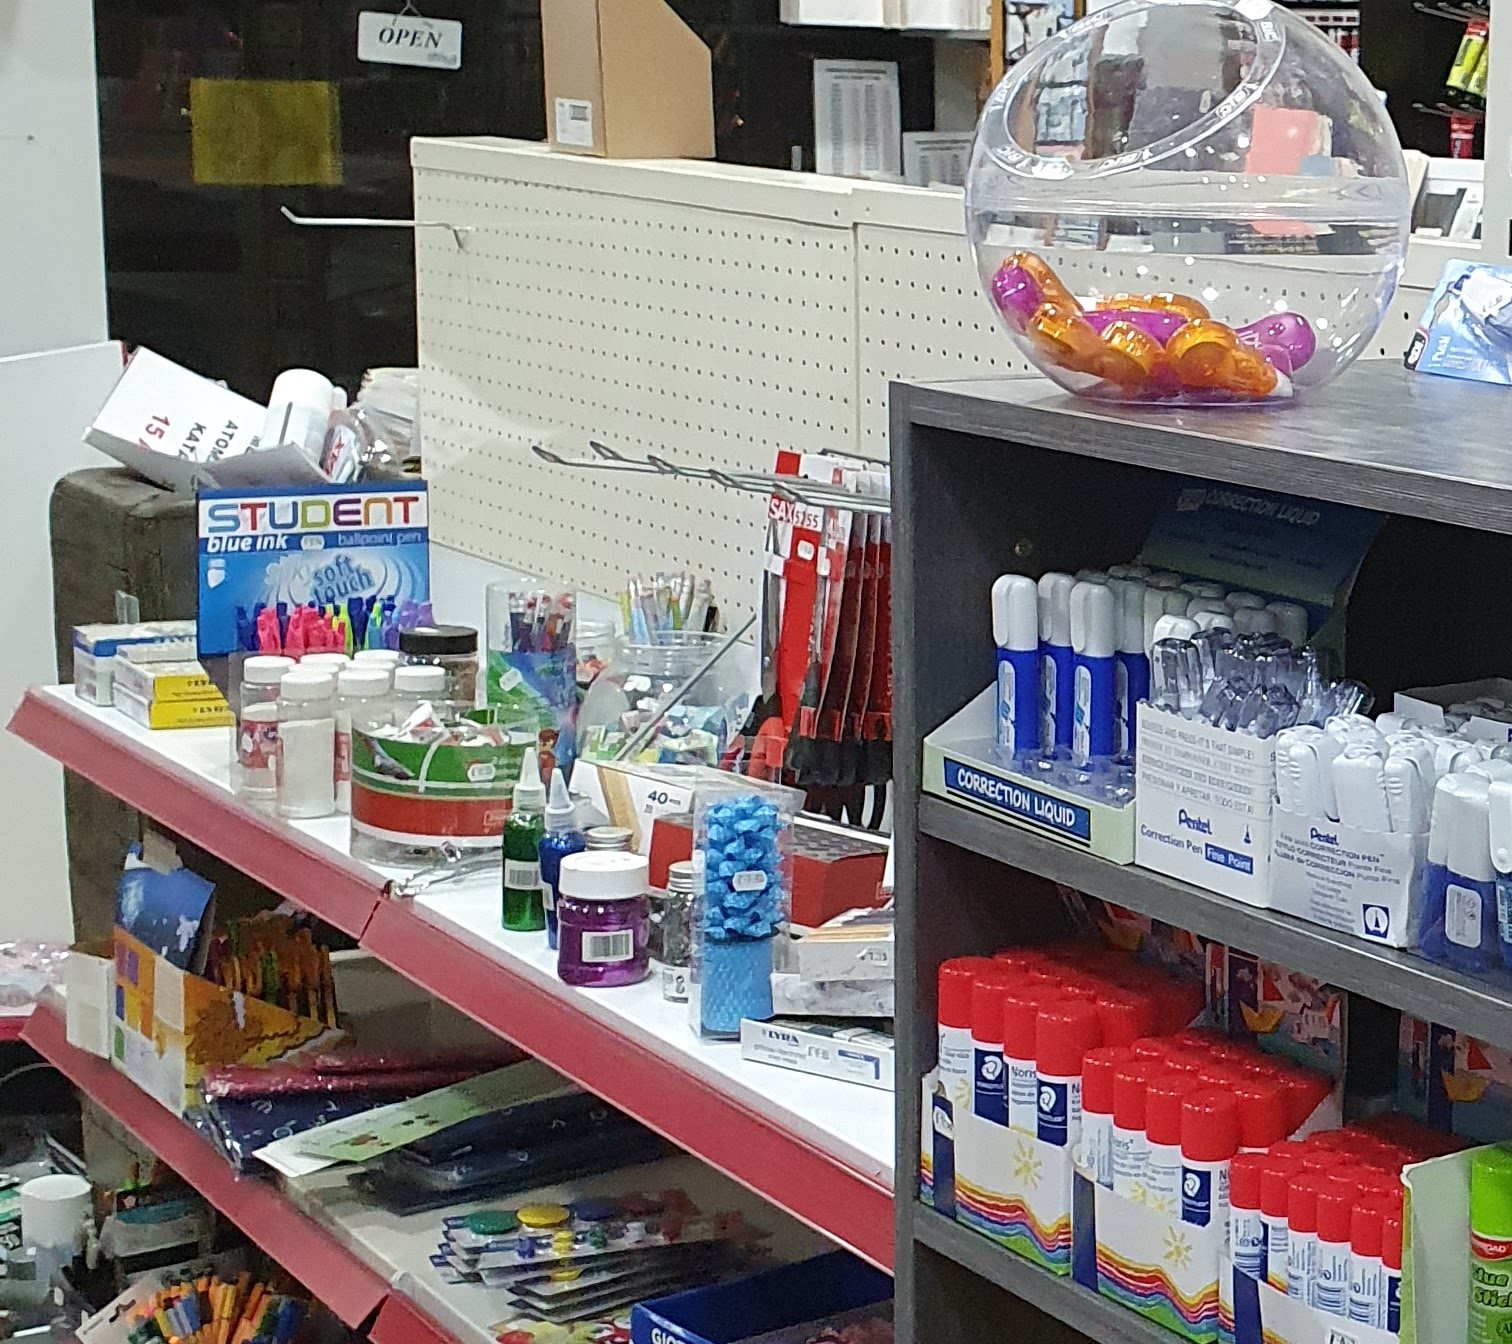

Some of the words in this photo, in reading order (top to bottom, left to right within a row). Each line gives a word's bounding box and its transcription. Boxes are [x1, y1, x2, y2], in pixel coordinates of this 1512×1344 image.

[377, 25, 443, 50] OPEN
[207, 495, 420, 534] STUDENT
[769, 498, 795, 523] SAX
[206, 535, 253, 554] blue
[256, 534, 289, 551] ink
[395, 530, 422, 545] pen
[314, 554, 354, 586] soft
[313, 567, 375, 605] touch
[957, 767, 1032, 813] CORRECTION
[1034, 795, 1077, 830] LIQUID
[1178, 808, 1213, 836] Pentel
[1140, 823, 1185, 849] Correction
[1186, 839, 1204, 855] Pen
[1206, 846, 1226, 864] Fine
